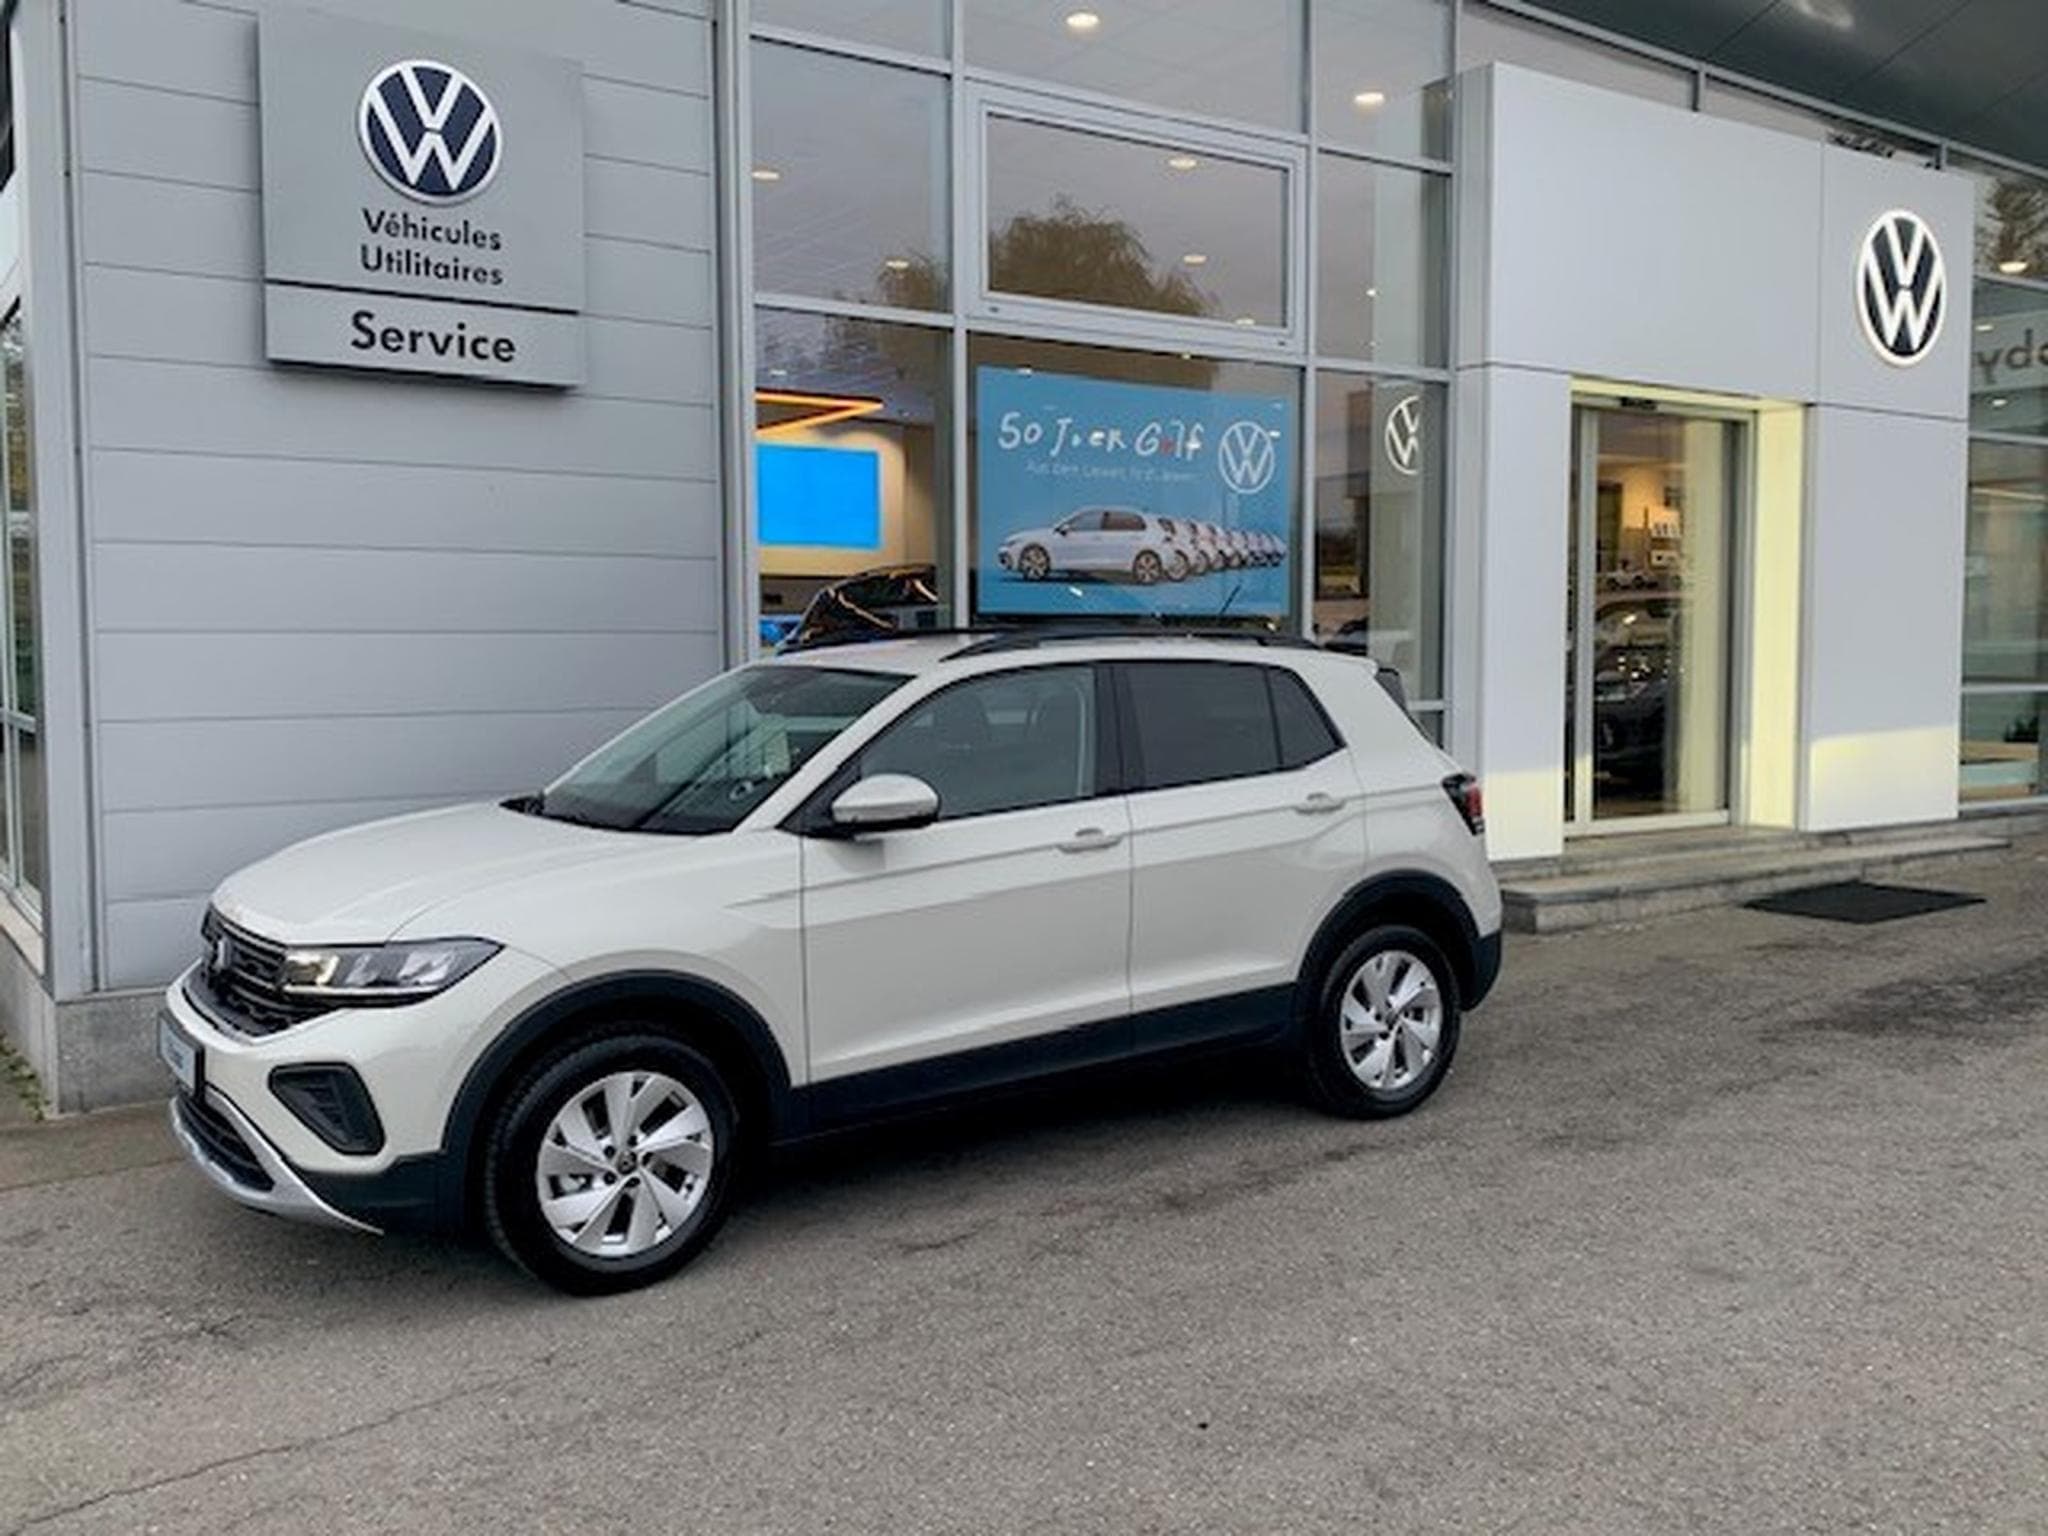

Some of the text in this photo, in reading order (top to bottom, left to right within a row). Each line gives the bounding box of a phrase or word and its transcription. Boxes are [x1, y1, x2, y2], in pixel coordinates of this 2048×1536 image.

[363, 60, 500, 200] VW
[362, 207, 501, 251] Véhicules
[361, 244, 503, 286] Utilitaires
[1860, 210, 1946, 362] VW
[350, 309, 516, 362] Service
